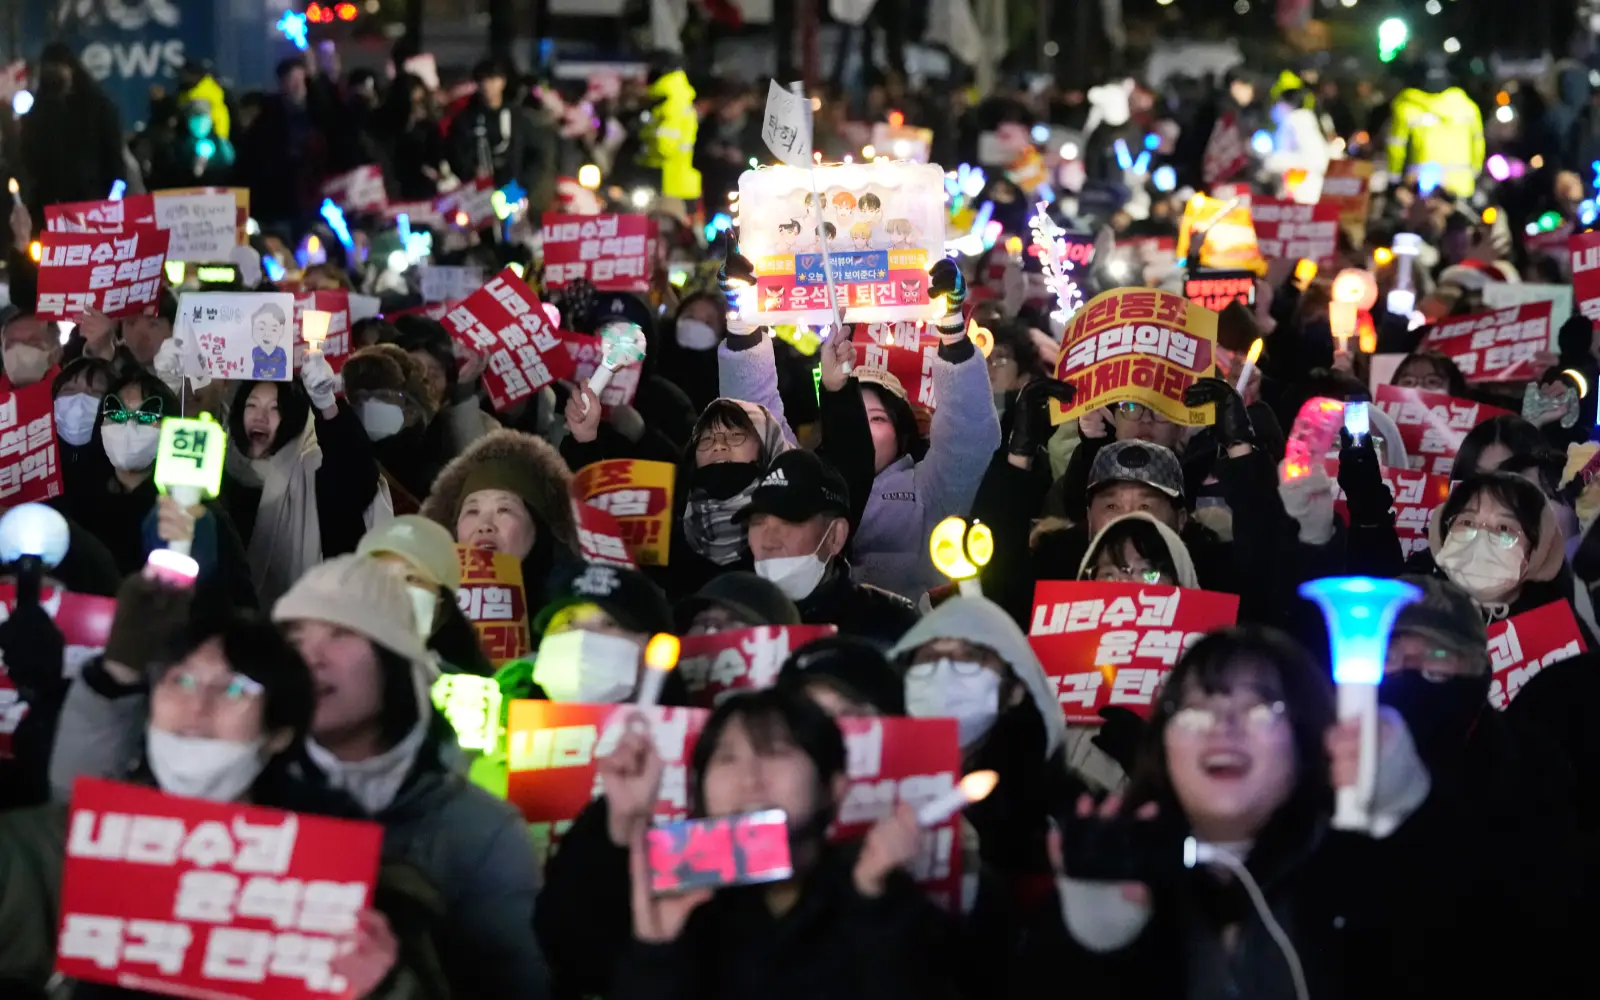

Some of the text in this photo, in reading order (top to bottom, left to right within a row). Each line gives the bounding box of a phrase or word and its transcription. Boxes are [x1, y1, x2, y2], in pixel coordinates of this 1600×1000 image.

[81, 39, 187, 80] ews
[40, 232, 139, 267] 내란수괴
[89, 253, 165, 290] 윤석열
[37, 277, 161, 316] 즉각 탄핵!
[788, 280, 898, 309] 윤석열 퇴진
[844, 268, 877, 280] 보여준다
[483, 277, 562, 353] 내란수괴
[1060, 292, 1189, 352] 내란동조
[1428, 305, 1521, 341] 내란수괴
[447, 305, 498, 350] 즉각
[488, 348, 532, 401] 탄핵!
[498, 323, 554, 390] 윤석열
[1066, 325, 1198, 372] 국민의힘
[171, 428, 209, 469] 핵
[1030, 586, 1181, 637] 내란수괴
[67, 808, 298, 875] 내란수괴
[174, 869, 367, 935] 윤석열
[59, 912, 194, 975] 즉각
